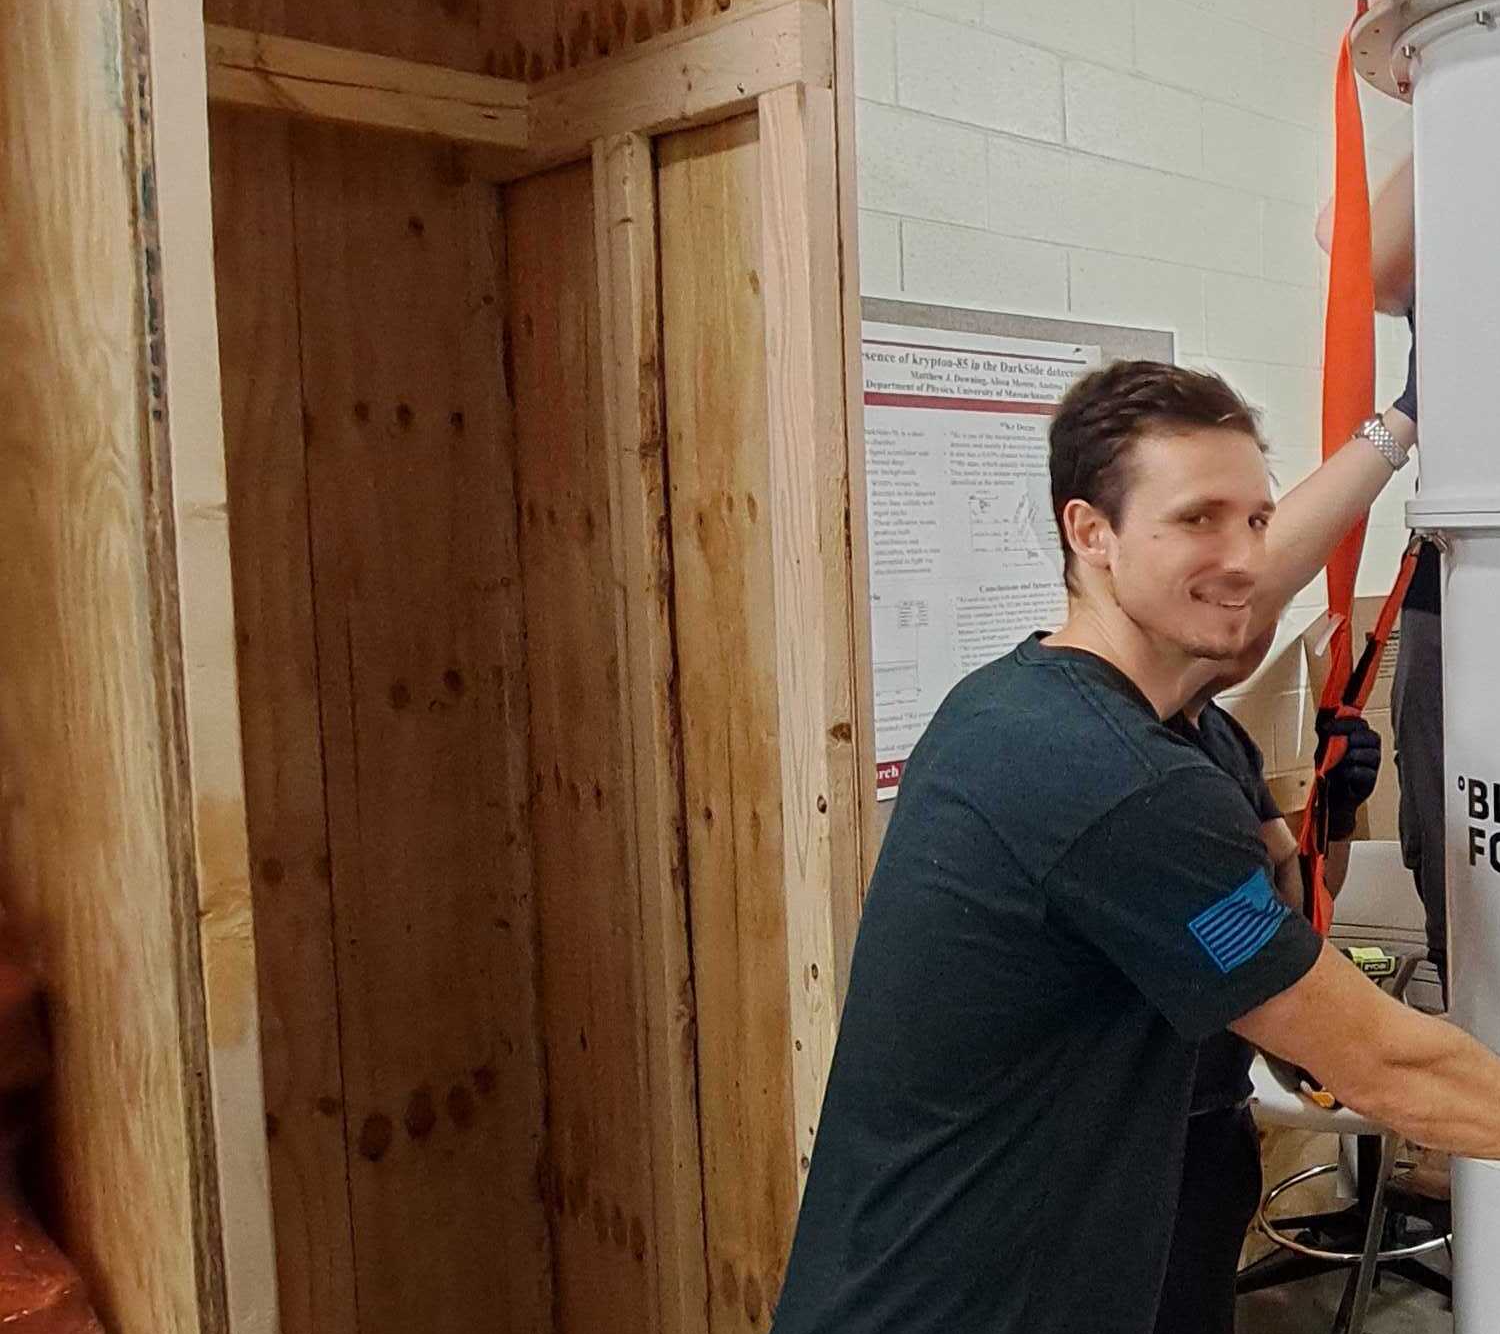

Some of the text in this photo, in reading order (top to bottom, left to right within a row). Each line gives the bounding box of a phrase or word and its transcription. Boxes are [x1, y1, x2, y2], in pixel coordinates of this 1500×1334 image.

[861, 350, 896, 364] sence
[897, 352, 910, 364] of
[912, 353, 969, 370] krypton-85
[971, 359, 981, 370] in
[982, 359, 999, 372] the
[1000, 361, 1043, 376] DarkSide
[865, 378, 914, 391] Department
[916, 382, 925, 392] of
[957, 386, 993, 397] University
[996, 388, 1004, 396] of
[876, 764, 899, 780] rch
